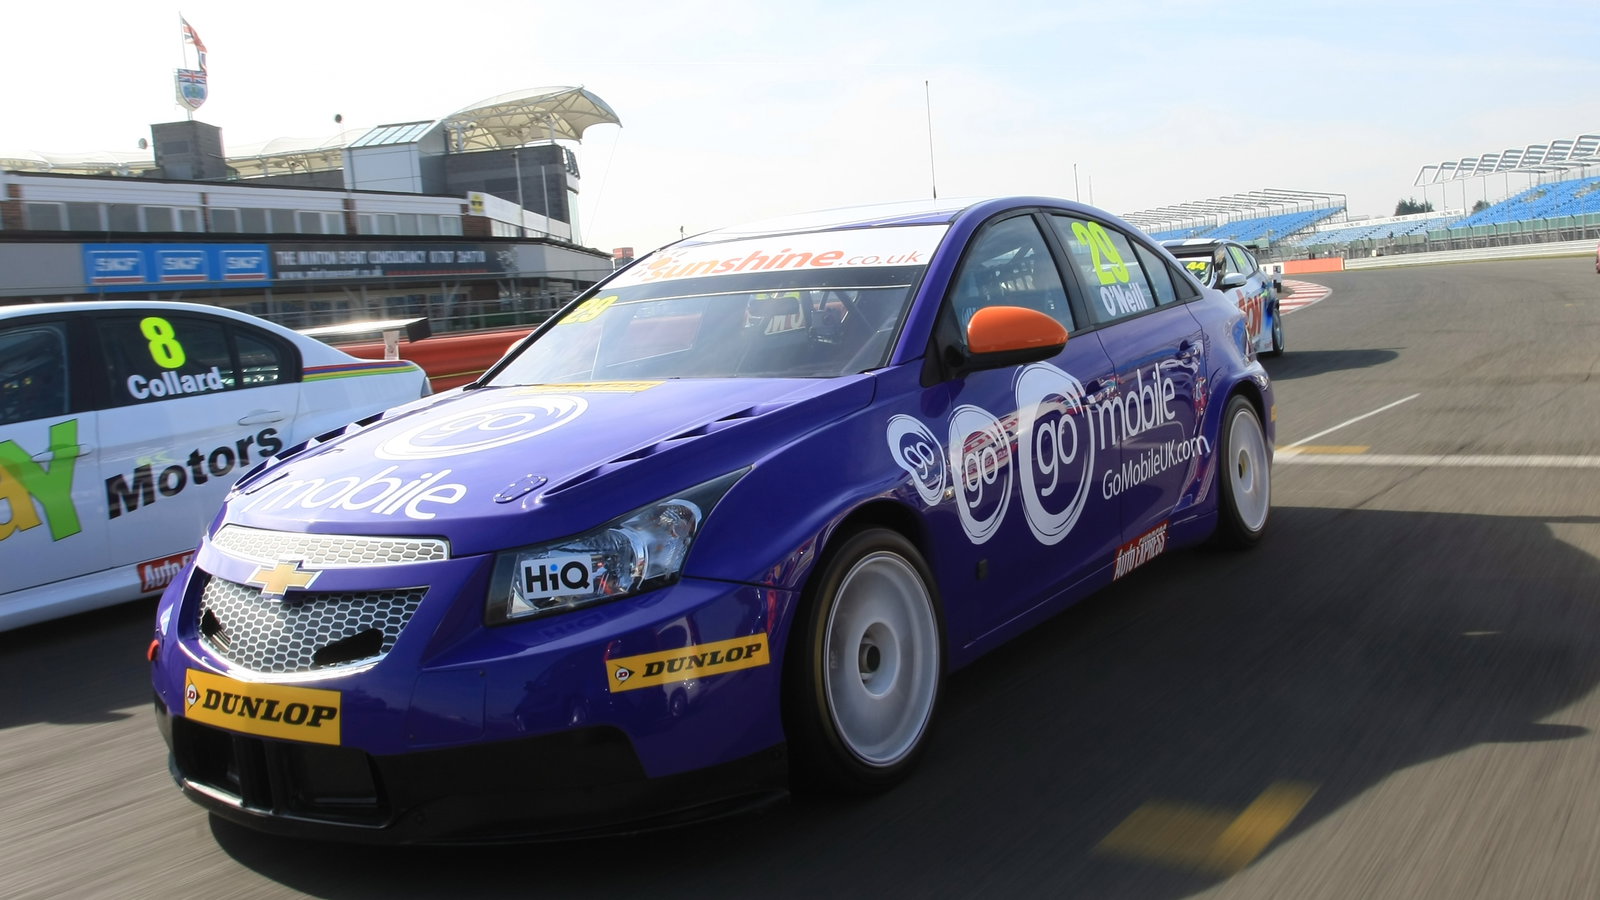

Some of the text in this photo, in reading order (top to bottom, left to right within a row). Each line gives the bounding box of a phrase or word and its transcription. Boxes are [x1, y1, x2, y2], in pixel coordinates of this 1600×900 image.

[96, 257, 139, 271] SKF
[163, 256, 203, 270] SKF
[227, 256, 262, 269] SKF
[275, 251, 296, 265] THE
[1071, 221, 1129, 285] 29
[1100, 282, 1147, 317] O'Neill
[139, 316, 186, 369] 8
[127, 366, 223, 399] Collard
[1099, 362, 1175, 450] mobile
[105, 427, 283, 520] Motors
[904, 440, 936, 479] go
[1036, 413, 1078, 497] go
[1102, 434, 1211, 500] GoMobileUK.com
[240, 465, 467, 519] mobile
[965, 446, 998, 508] go
[144, 560, 180, 590] Auto
[525, 560, 590, 594] HiQ
[642, 642, 762, 678] DUNLOP
[202, 688, 338, 728] DUNLOP
